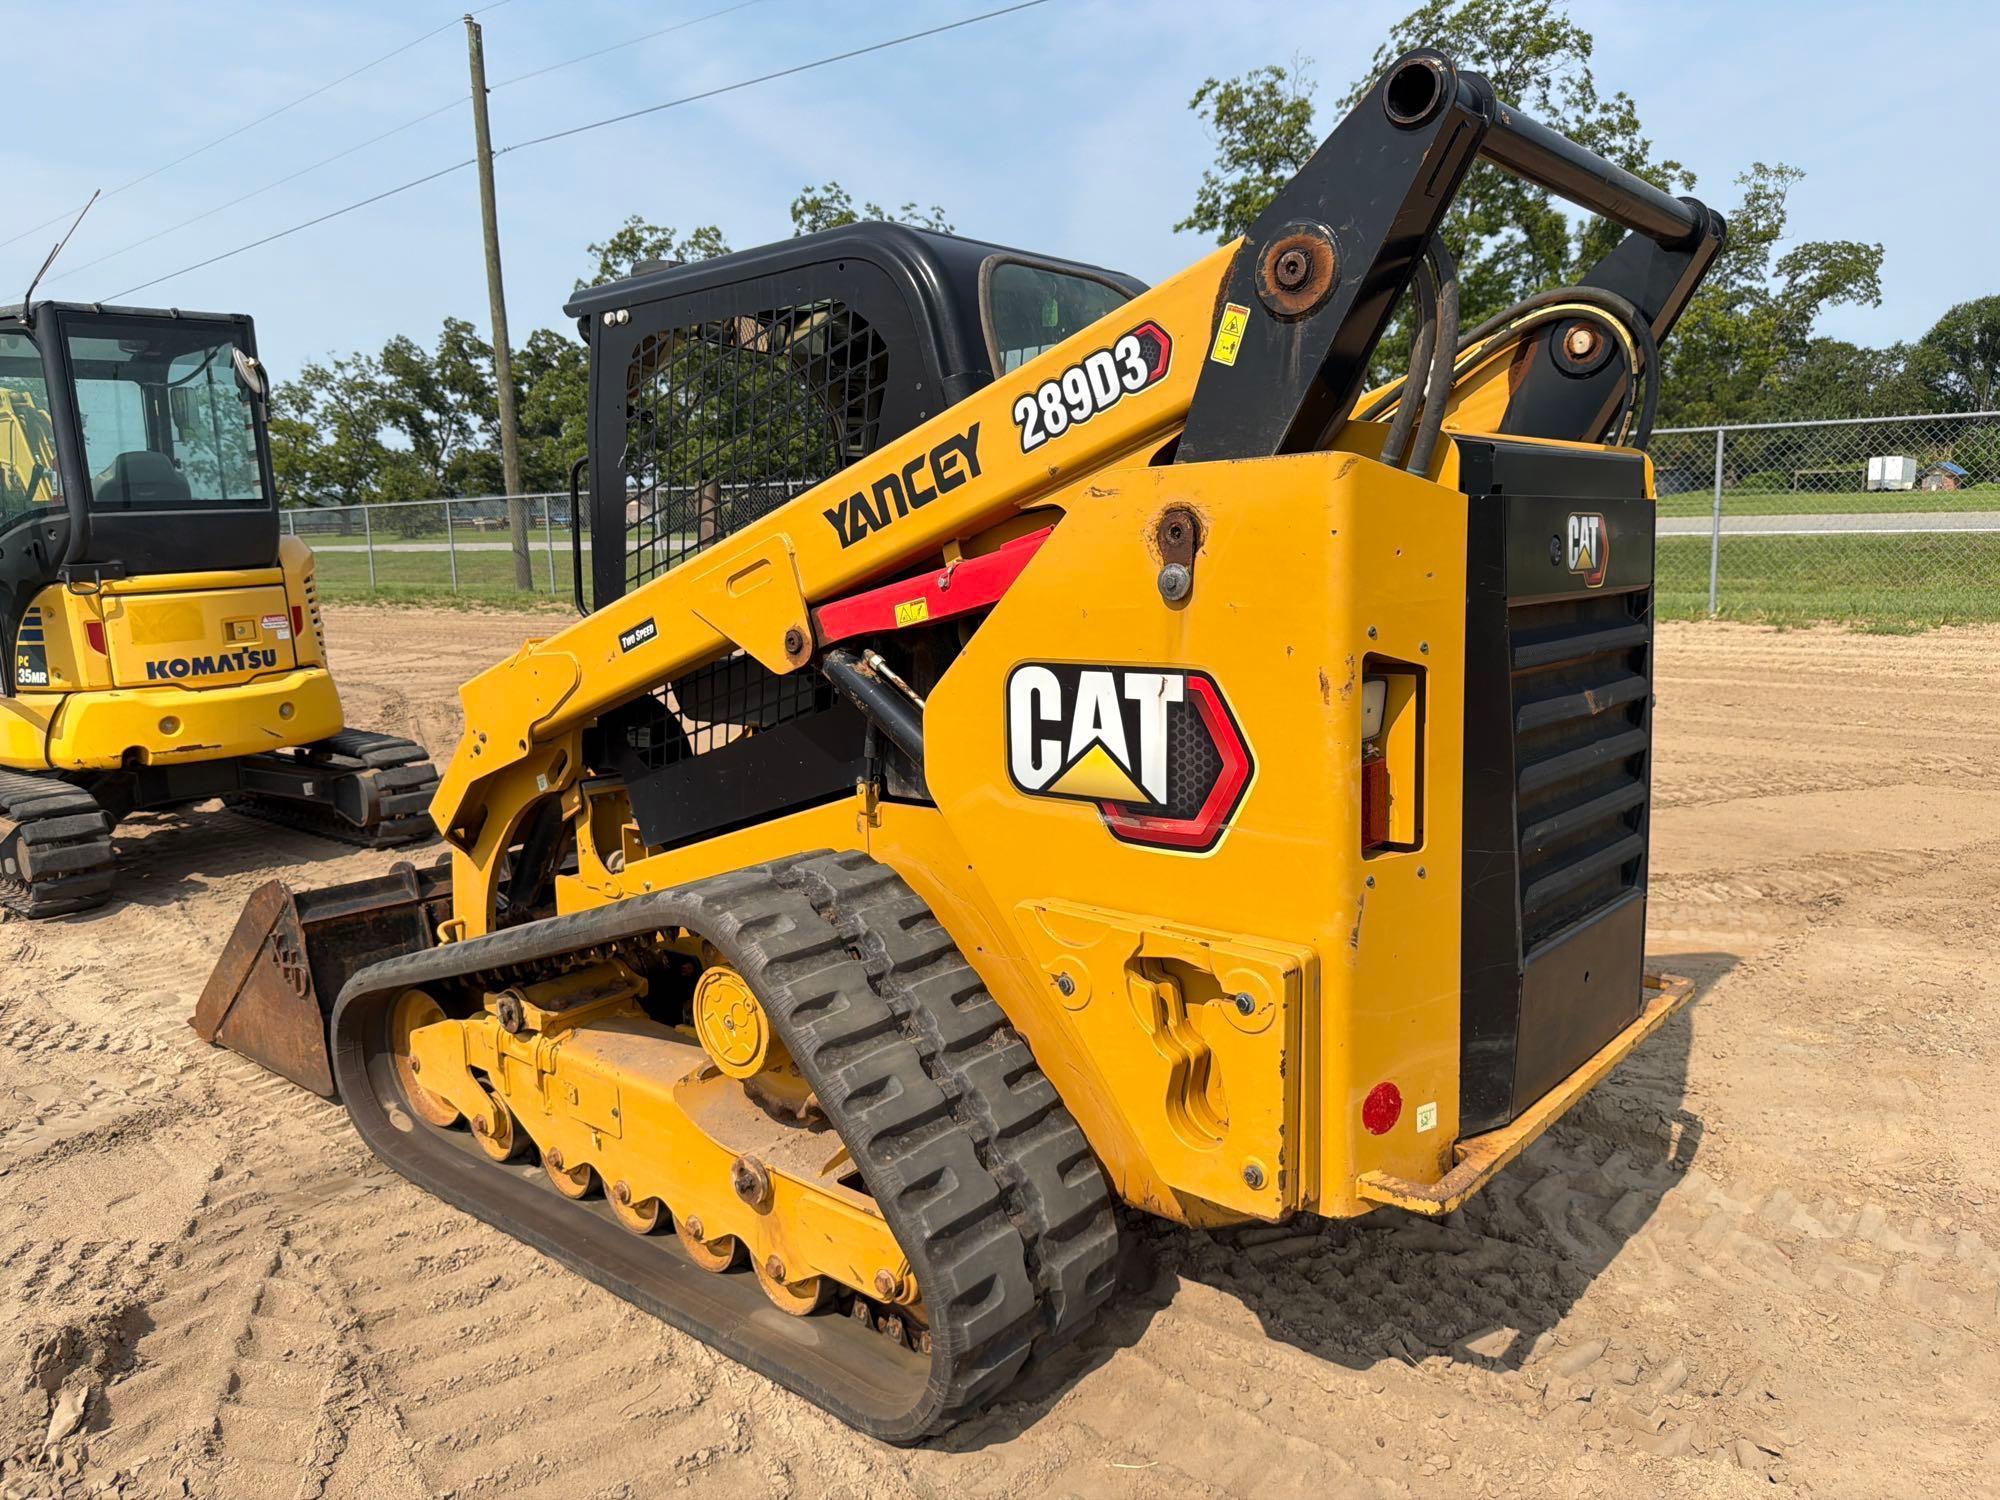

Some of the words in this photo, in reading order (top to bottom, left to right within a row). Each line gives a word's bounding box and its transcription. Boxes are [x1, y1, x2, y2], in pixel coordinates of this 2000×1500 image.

[1014, 334, 1149, 451] 289D3
[822, 421, 982, 550] YANCEY
[1568, 515, 1599, 570] CAT
[18, 655, 29, 667] PC
[18, 668, 47, 683] 35MR
[146, 646, 277, 680] KOMATSU
[1009, 665, 1184, 806] CAT
